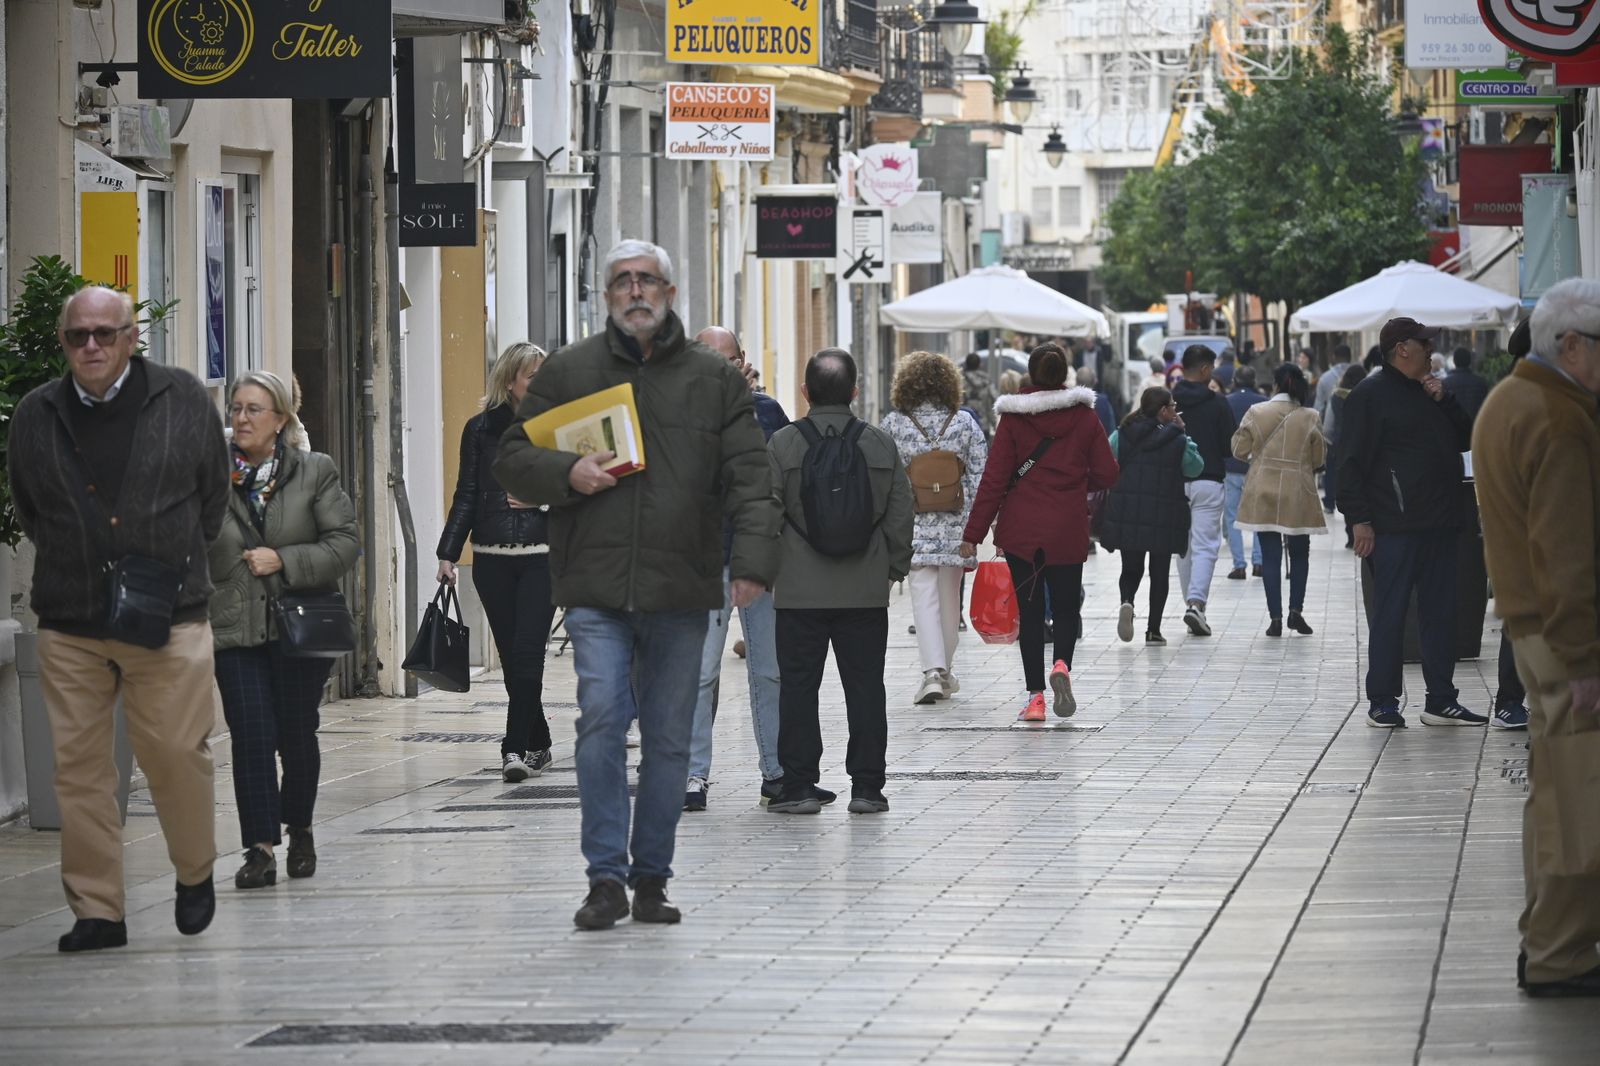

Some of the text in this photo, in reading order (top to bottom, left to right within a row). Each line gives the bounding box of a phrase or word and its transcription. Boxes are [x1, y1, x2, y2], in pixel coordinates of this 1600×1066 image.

[272, 22, 363, 61] Taller
[673, 25, 812, 54] PELUQUEROS
[178, 42, 226, 58] Juanma
[1421, 43, 1492, 53] 959 26 30 00
[184, 55, 226, 72] Calado
[1466, 84, 1510, 94] CENTRO
[671, 106, 769, 120] PELUQUERIA
[670, 141, 770, 157] Caballeros y Niños
[402, 213, 465, 229] SOLE
[891, 222, 935, 232] Audika
